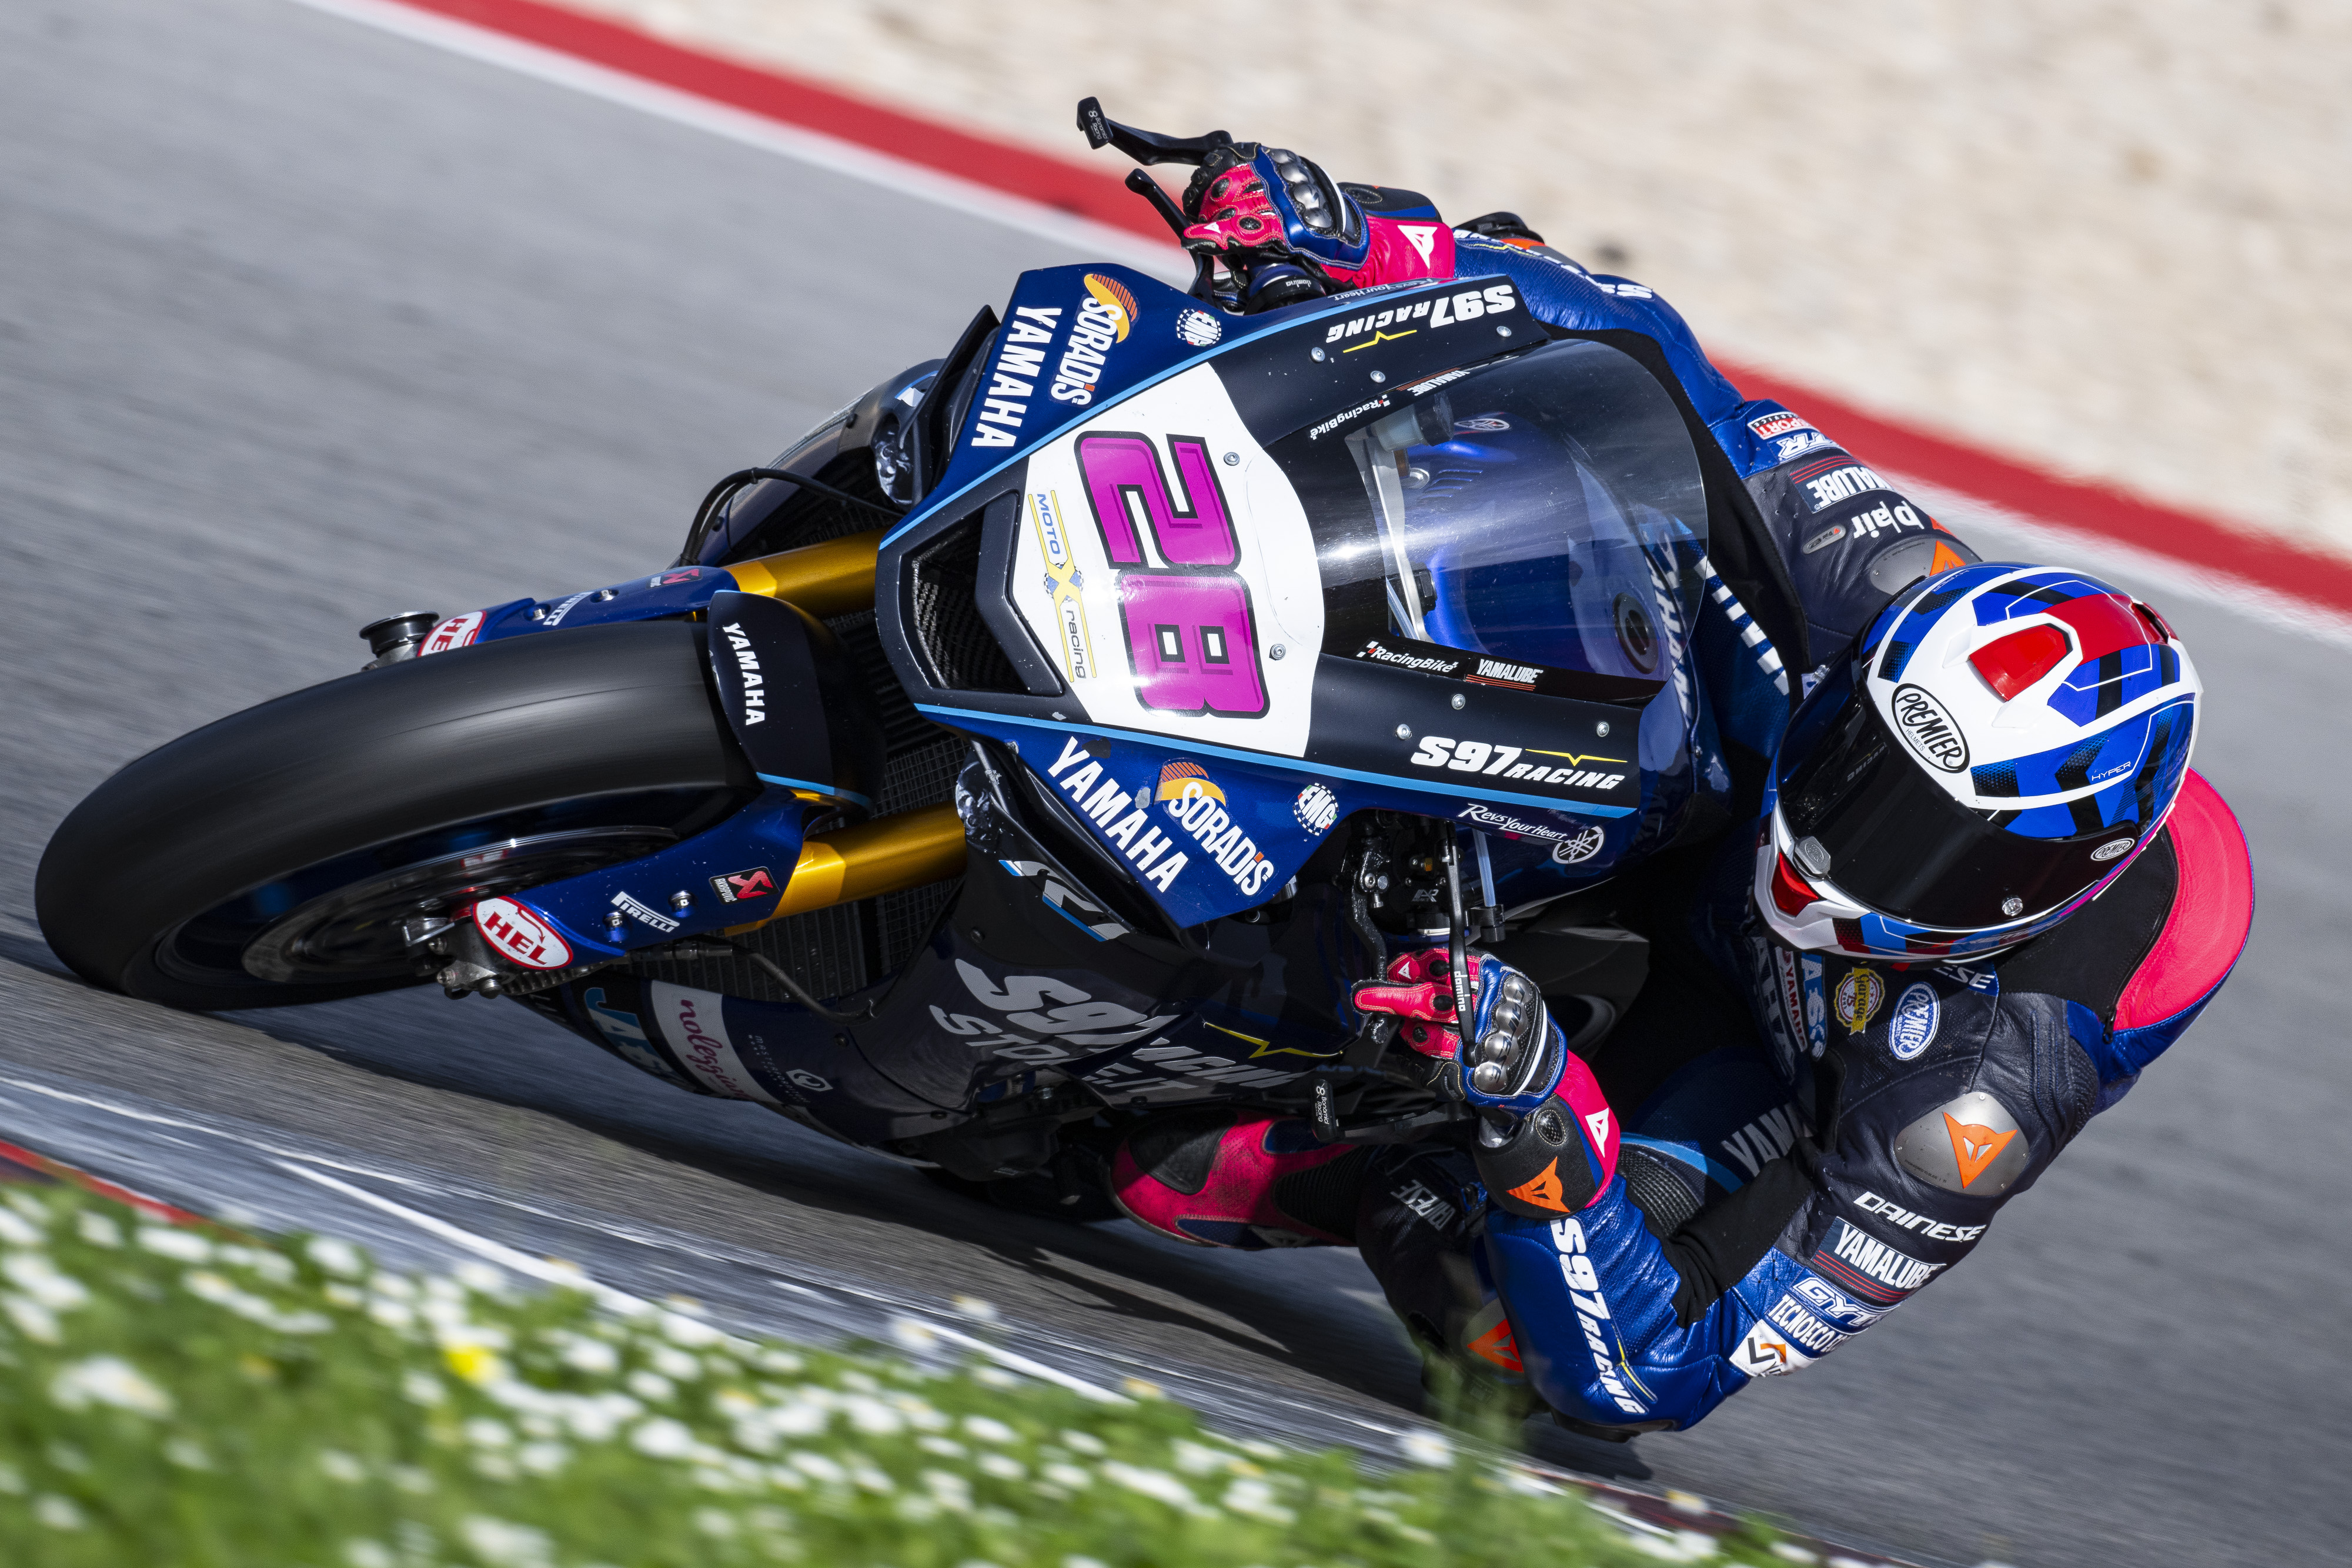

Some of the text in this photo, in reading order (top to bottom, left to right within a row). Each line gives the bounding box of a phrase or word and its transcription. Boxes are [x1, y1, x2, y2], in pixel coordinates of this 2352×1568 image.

[1184, 310, 1218, 346] EMG
[1326, 284, 1516, 343] S97 RACING
[971, 306, 1062, 447] YAMAHA
[1407, 370, 1470, 396] YAMALUBE
[1310, 400, 1381, 440] RacingBike
[1037, 493, 1060, 555] MOTO
[1066, 610, 1087, 680] racing
[1074, 430, 1270, 720] 28
[722, 622, 766, 726] YAMAHA
[1372, 647, 1543, 684] RacingBike YAMALUBE
[1896, 693, 1963, 769] PREMIER
[1906, 728, 1925, 751] HELMETS
[1410, 735, 1625, 790] S97 RACING
[2092, 761, 2131, 781] HYPER
[1047, 736, 1188, 892] YAMAHA
[1298, 785, 1336, 828] EMG
[485, 911, 549, 965] HEL
[611, 891, 680, 932] PIRELLI
[1454, 970, 1466, 1012] domino
[1899, 992, 1929, 1054] PREMIER
[1321, 1096, 1329, 1124] Bonamici
[1853, 1192, 1987, 1242] DAINESE
[1833, 1224, 1938, 1290] YAMALUBE
[1550, 1218, 1646, 1415] S97 RACING
